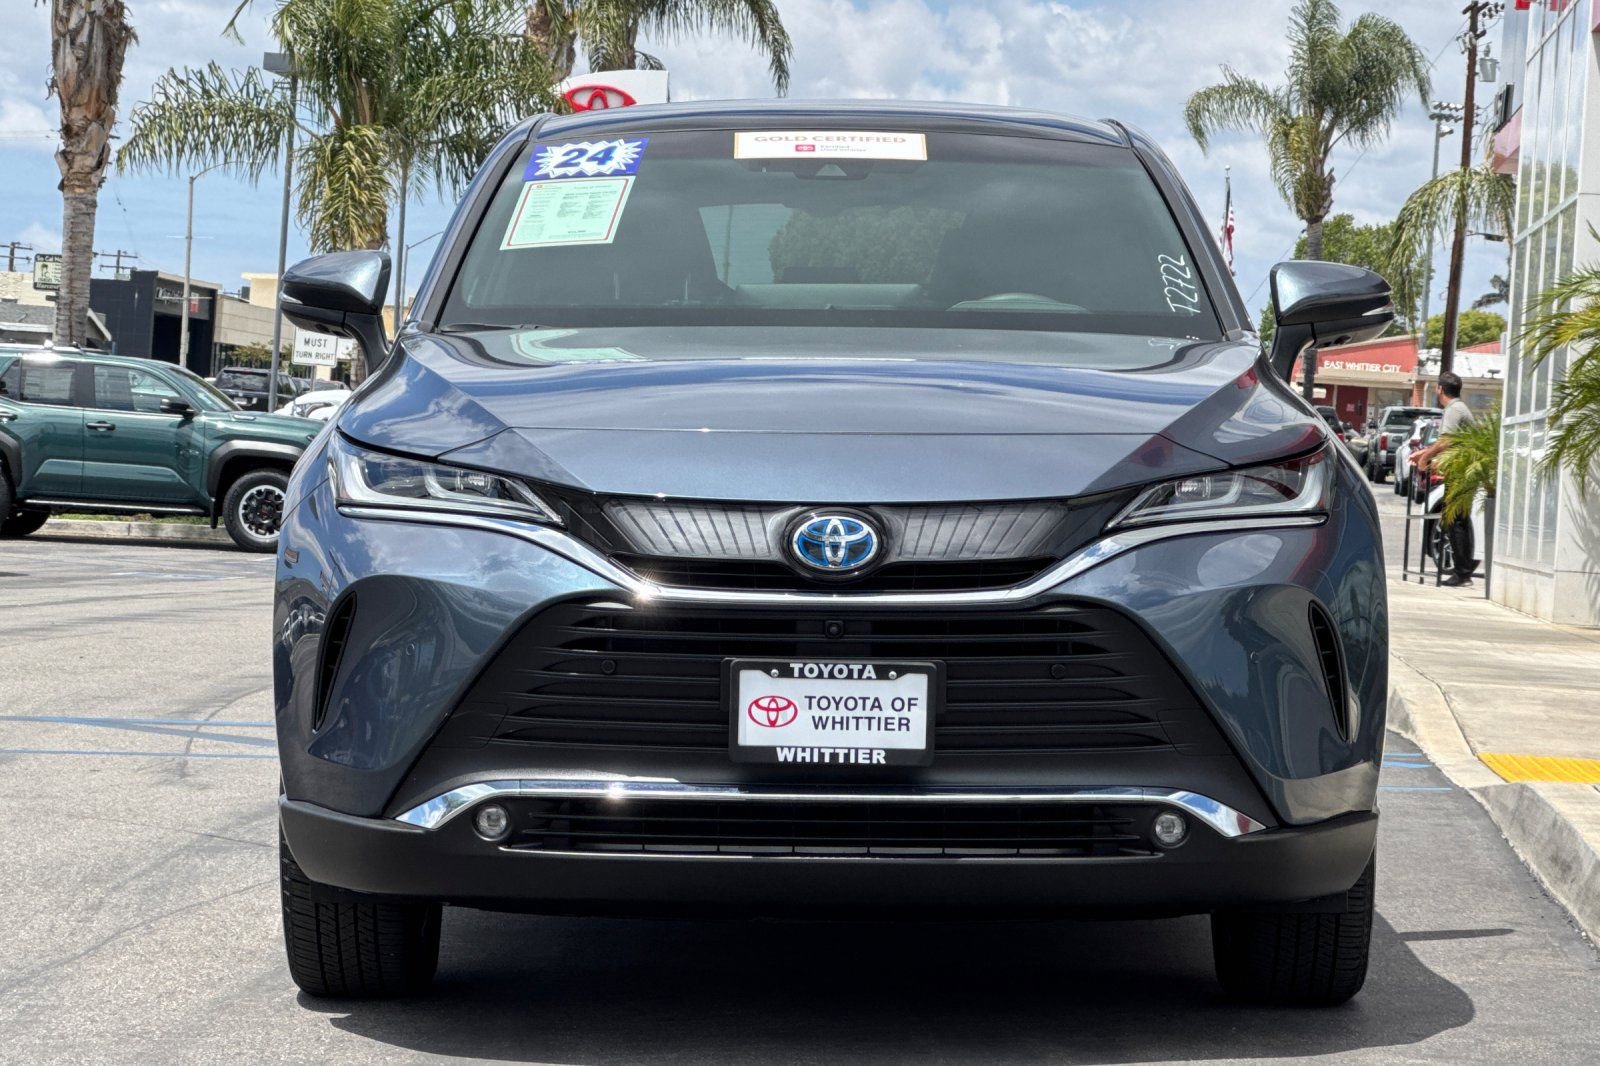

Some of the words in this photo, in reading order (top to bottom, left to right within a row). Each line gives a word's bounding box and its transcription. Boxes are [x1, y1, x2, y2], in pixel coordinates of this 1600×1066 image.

[812, 135, 906, 143] CERTIFIED
[553, 145, 619, 169] 24
[304, 337, 328, 347] MUST
[315, 352, 335, 360] RIGHT
[1324, 360, 1344, 369] EAST
[1345, 361, 1381, 372] WHITTIER
[1382, 363, 1401, 373] CITY
[790, 663, 877, 679] TOYOTA
[804, 695, 883, 712] TOYOTA
[891, 697, 919, 712] OF
[812, 715, 911, 732] WHITTIER
[776, 747, 887, 764] WHITTIER
